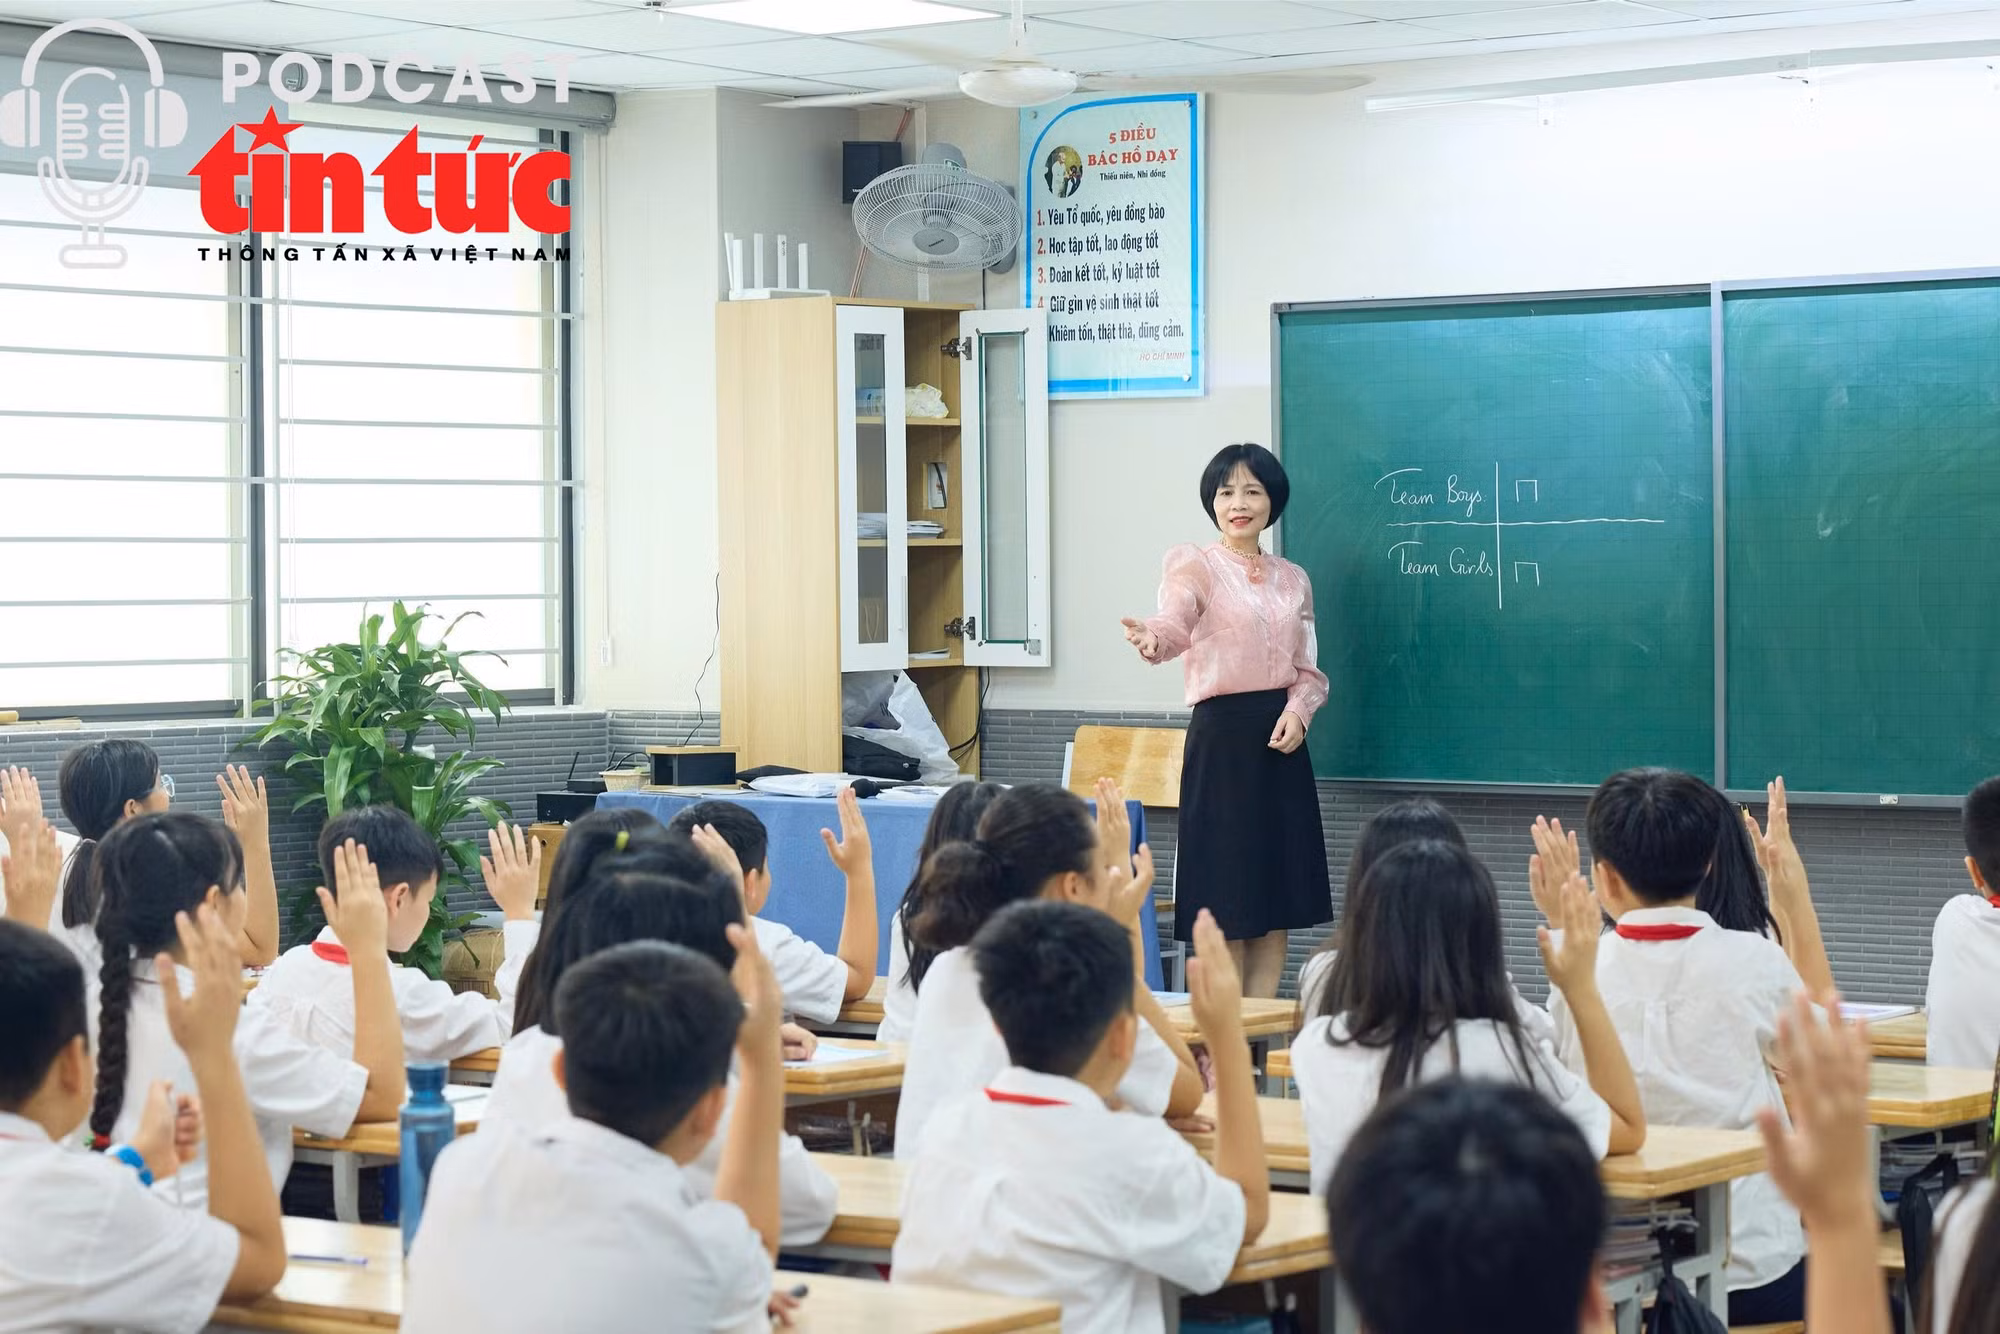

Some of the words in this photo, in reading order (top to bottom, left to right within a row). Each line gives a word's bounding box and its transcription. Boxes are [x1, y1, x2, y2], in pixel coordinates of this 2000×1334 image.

[1108, 132, 1117, 144] 5
[1120, 122, 1156, 142] ĐIỀU
[1088, 150, 1118, 166] BÁC
[1121, 145, 1142, 164] HỒ
[1146, 148, 1179, 164] DẠY
[1099, 171, 1118, 181] Thiếu
[1137, 169, 1148, 178] Nhi
[1037, 208, 1045, 226] 1.
[1048, 208, 1064, 225] Yêu
[1066, 203, 1079, 225] Tổ
[1080, 203, 1104, 227] quốc,
[1106, 205, 1122, 225] yêu
[1124, 201, 1146, 223] đồng
[1148, 202, 1165, 219] bào
[1037, 238, 1046, 254] 2.
[1049, 237, 1066, 257] Học
[1069, 236, 1083, 256] tập
[1086, 232, 1102, 254] tốt,
[1105, 234, 1118, 251] lao
[1121, 233, 1143, 253] động
[1145, 229, 1159, 249] tốt
[1037, 266, 1046, 284] 3.
[1049, 266, 1072, 283] Đoàn
[1075, 262, 1090, 282] kết
[1093, 261, 1109, 284] tốt,
[1112, 261, 1123, 283] kỷ
[1126, 262, 1143, 283] luật
[1146, 259, 1160, 279] tốt
[1050, 295, 1066, 312] Giữ
[1068, 294, 1083, 315] gìn
[1086, 293, 1097, 314] vệ
[1099, 293, 1119, 310] sinh
[1122, 292, 1142, 312] thật
[1145, 288, 1159, 308] tốt
[1049, 324, 1076, 342] Khiêm
[1078, 321, 1096, 343] tốn,
[1098, 323, 1116, 343] thật
[1118, 321, 1136, 342] thà,
[1138, 321, 1160, 341] dũng
[1162, 318, 1184, 338] cảm.
[1374, 468, 1434, 504] Team
[1388, 541, 1439, 577] Team
[1449, 547, 1493, 577] Girls
